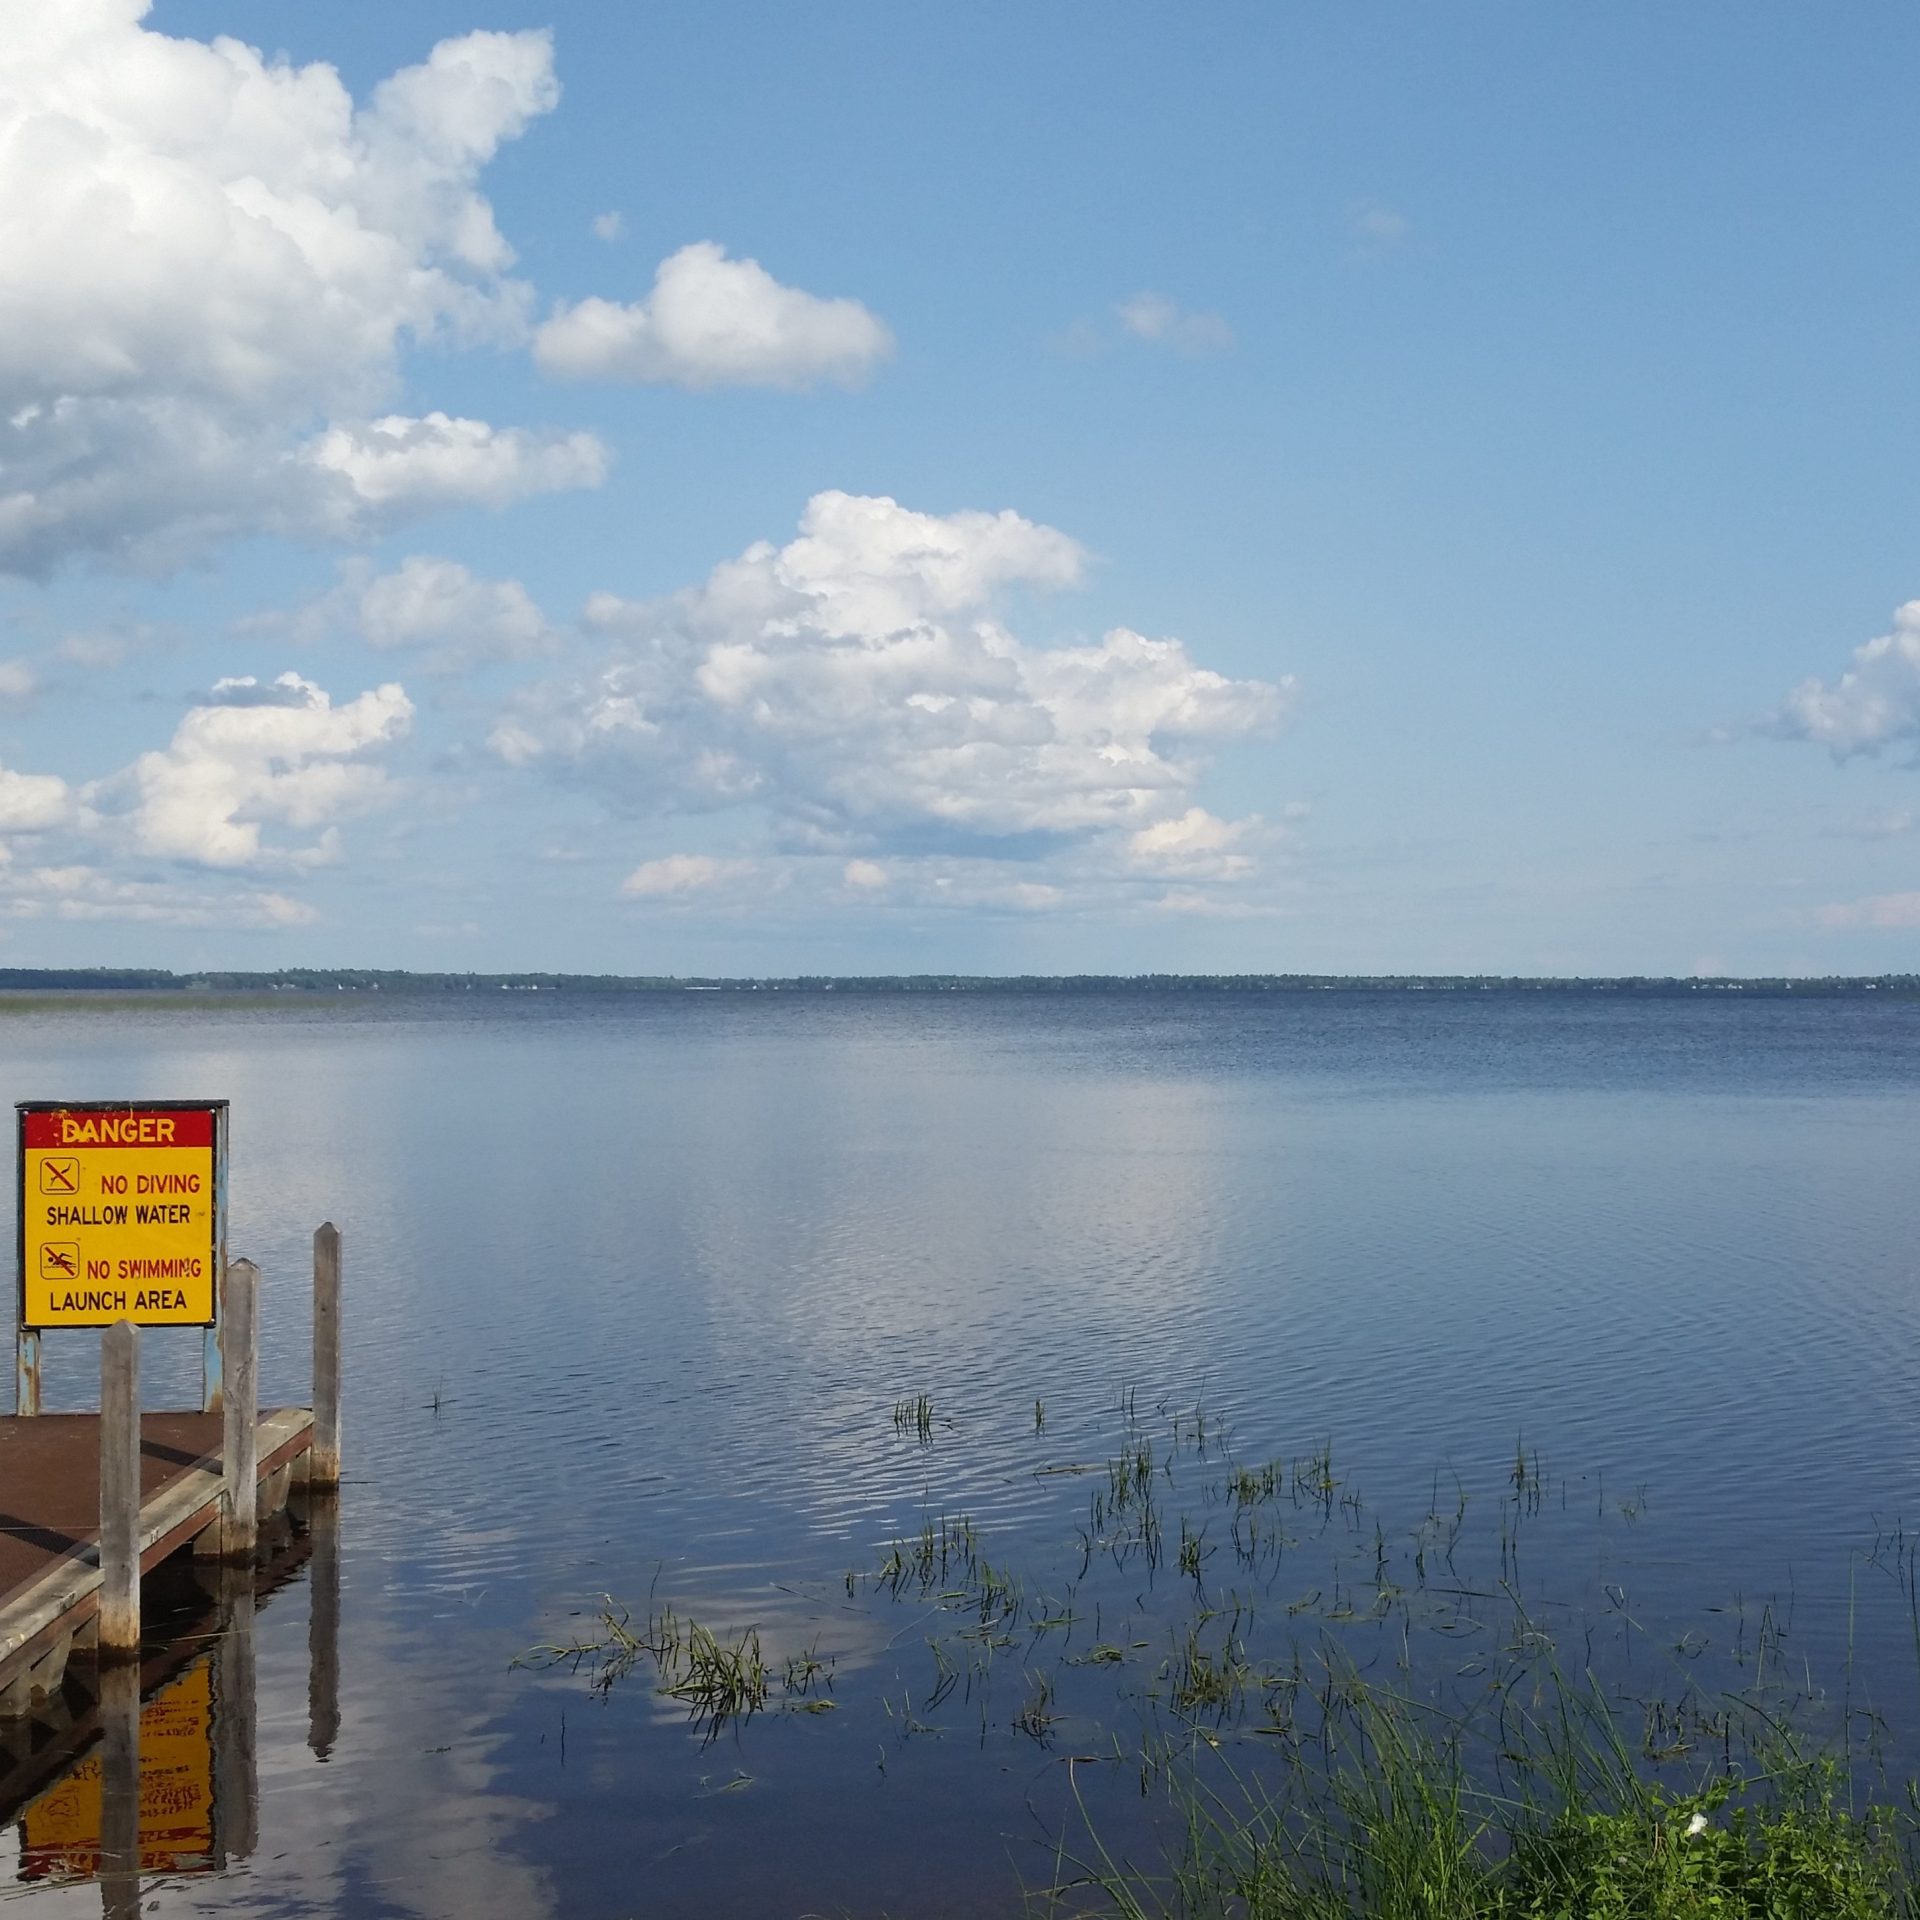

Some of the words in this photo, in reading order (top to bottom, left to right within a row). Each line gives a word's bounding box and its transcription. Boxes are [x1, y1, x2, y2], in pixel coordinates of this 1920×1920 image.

[62, 1118, 175, 1143] DANGER
[101, 1175, 128, 1195] NO
[136, 1174, 200, 1194] DIVING
[46, 1205, 128, 1226] SHALLOW
[136, 1204, 190, 1225] WATER
[87, 1260, 110, 1280] NO
[118, 1258, 201, 1280] SWIMMING
[50, 1291, 126, 1311] LAUNCH
[134, 1290, 187, 1310] AREA
